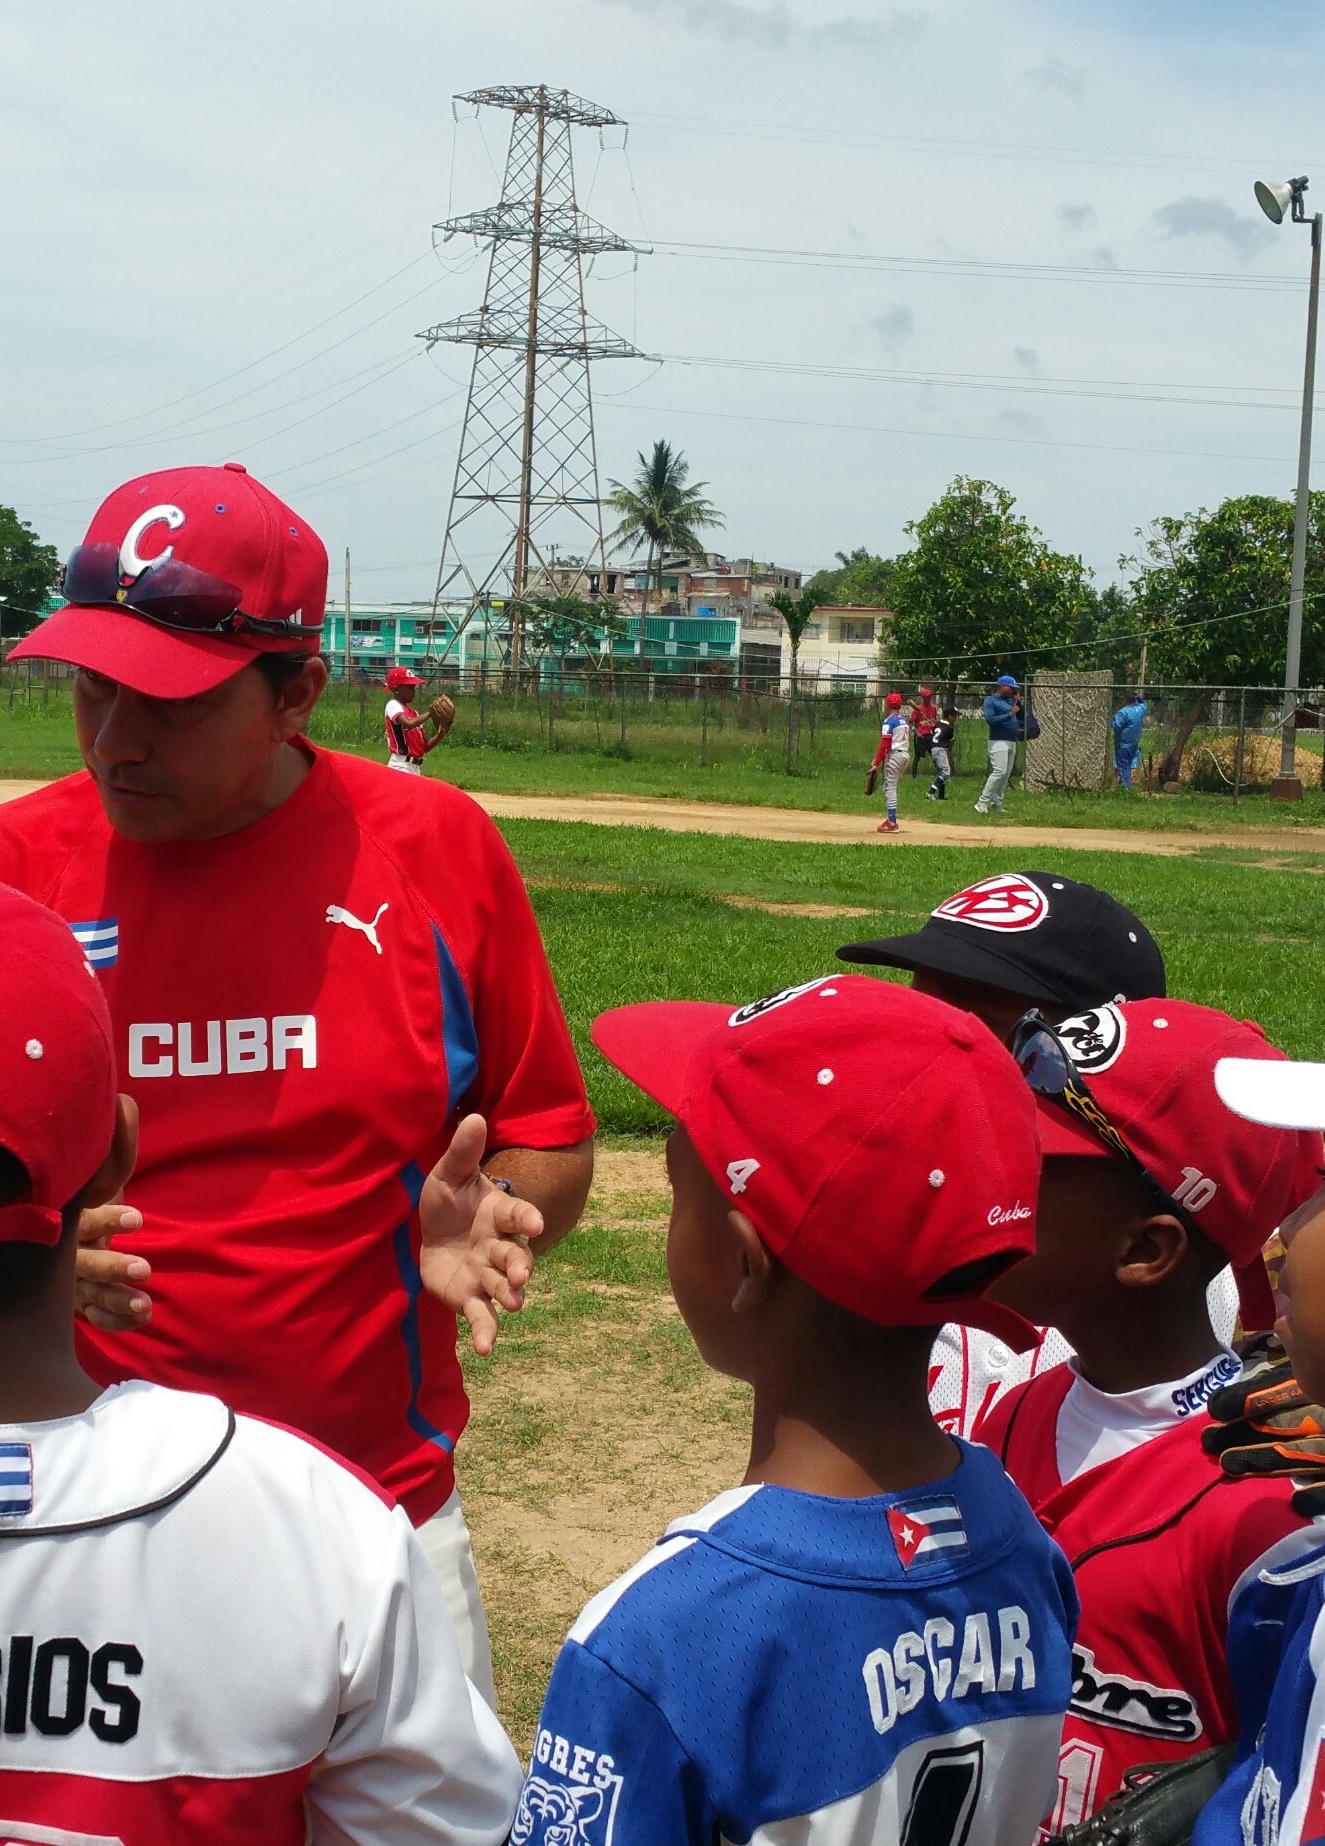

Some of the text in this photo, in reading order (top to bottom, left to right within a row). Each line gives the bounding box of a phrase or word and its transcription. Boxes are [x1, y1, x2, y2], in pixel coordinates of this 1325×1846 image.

[119, 504, 185, 584] C
[932, 728, 942, 744] 2
[129, 1015, 317, 1078] CUBA
[726, 1158, 761, 1195] 4
[1171, 1166, 1217, 1213] 10
[987, 1199, 1032, 1226] Cuba
[862, 1605, 1036, 1735] OSCAR
